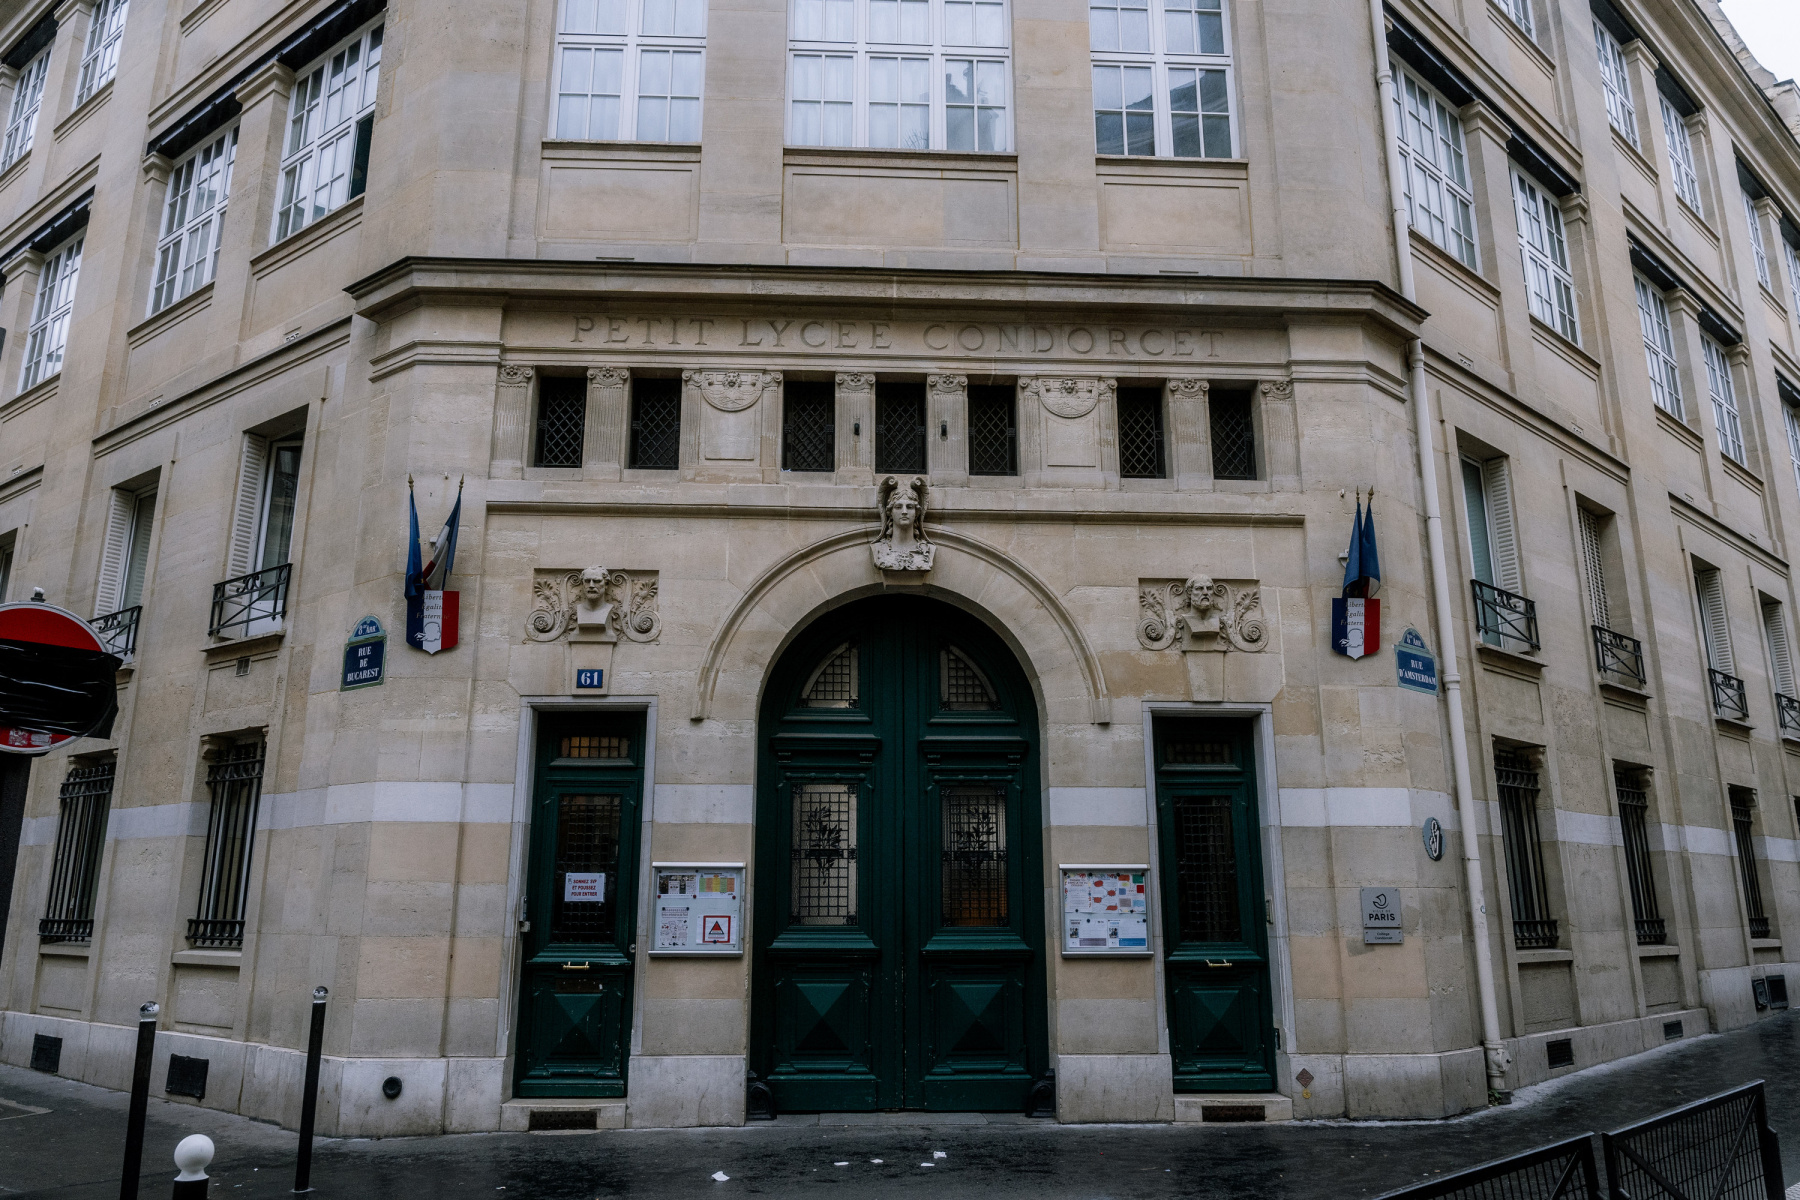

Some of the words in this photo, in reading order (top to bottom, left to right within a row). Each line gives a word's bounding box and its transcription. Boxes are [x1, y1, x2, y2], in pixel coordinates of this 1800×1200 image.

[570, 315, 714, 346] PETIT
[738, 318, 893, 349] LYCEE
[923, 323, 1224, 357] CONDORCET
[358, 646, 371, 657] RUE
[360, 658, 368, 668] DE
[1410, 659, 1423, 670] RUE
[347, 667, 379, 682] BUCAREST
[581, 671, 598, 686] 61
[1399, 668, 1436, 685] D'AMSTERDAM
[1369, 913, 1396, 921] PARIS
